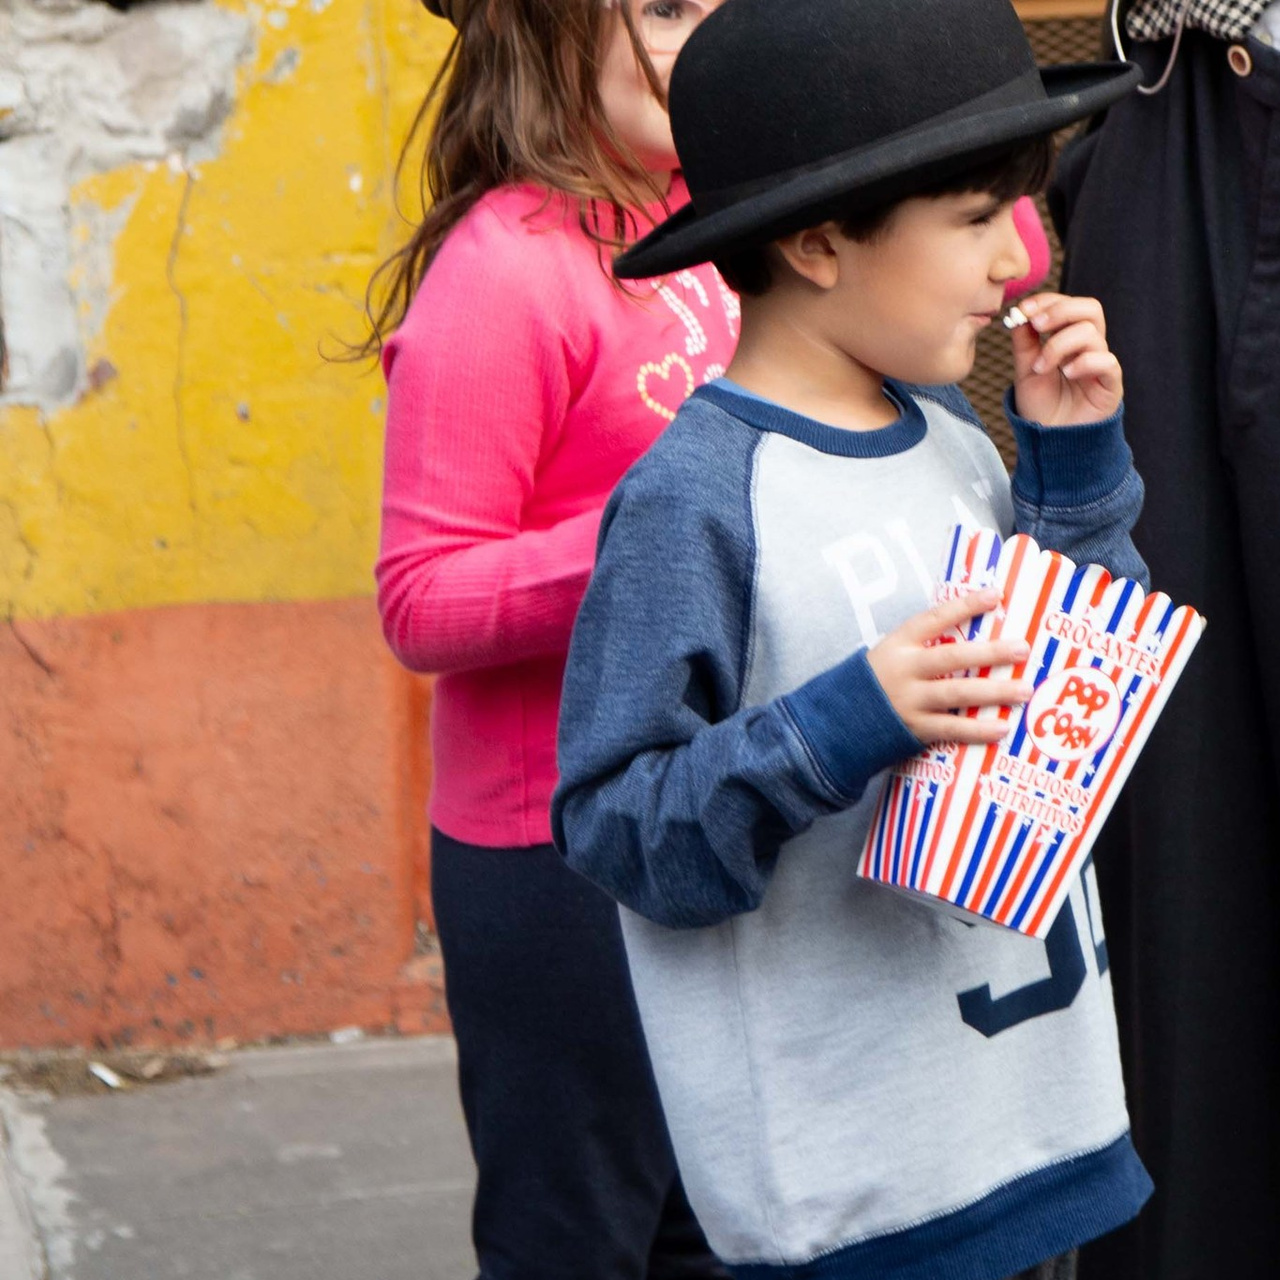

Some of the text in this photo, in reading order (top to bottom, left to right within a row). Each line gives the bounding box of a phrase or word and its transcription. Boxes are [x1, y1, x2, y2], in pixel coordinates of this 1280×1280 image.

[1044, 613, 1159, 677] CROCANTES
[1055, 674, 1110, 720] POP
[1033, 707, 1100, 750] CORN
[997, 754, 1092, 807] DELICIOSOS
[982, 783, 1082, 833] NUTRITIVOS
